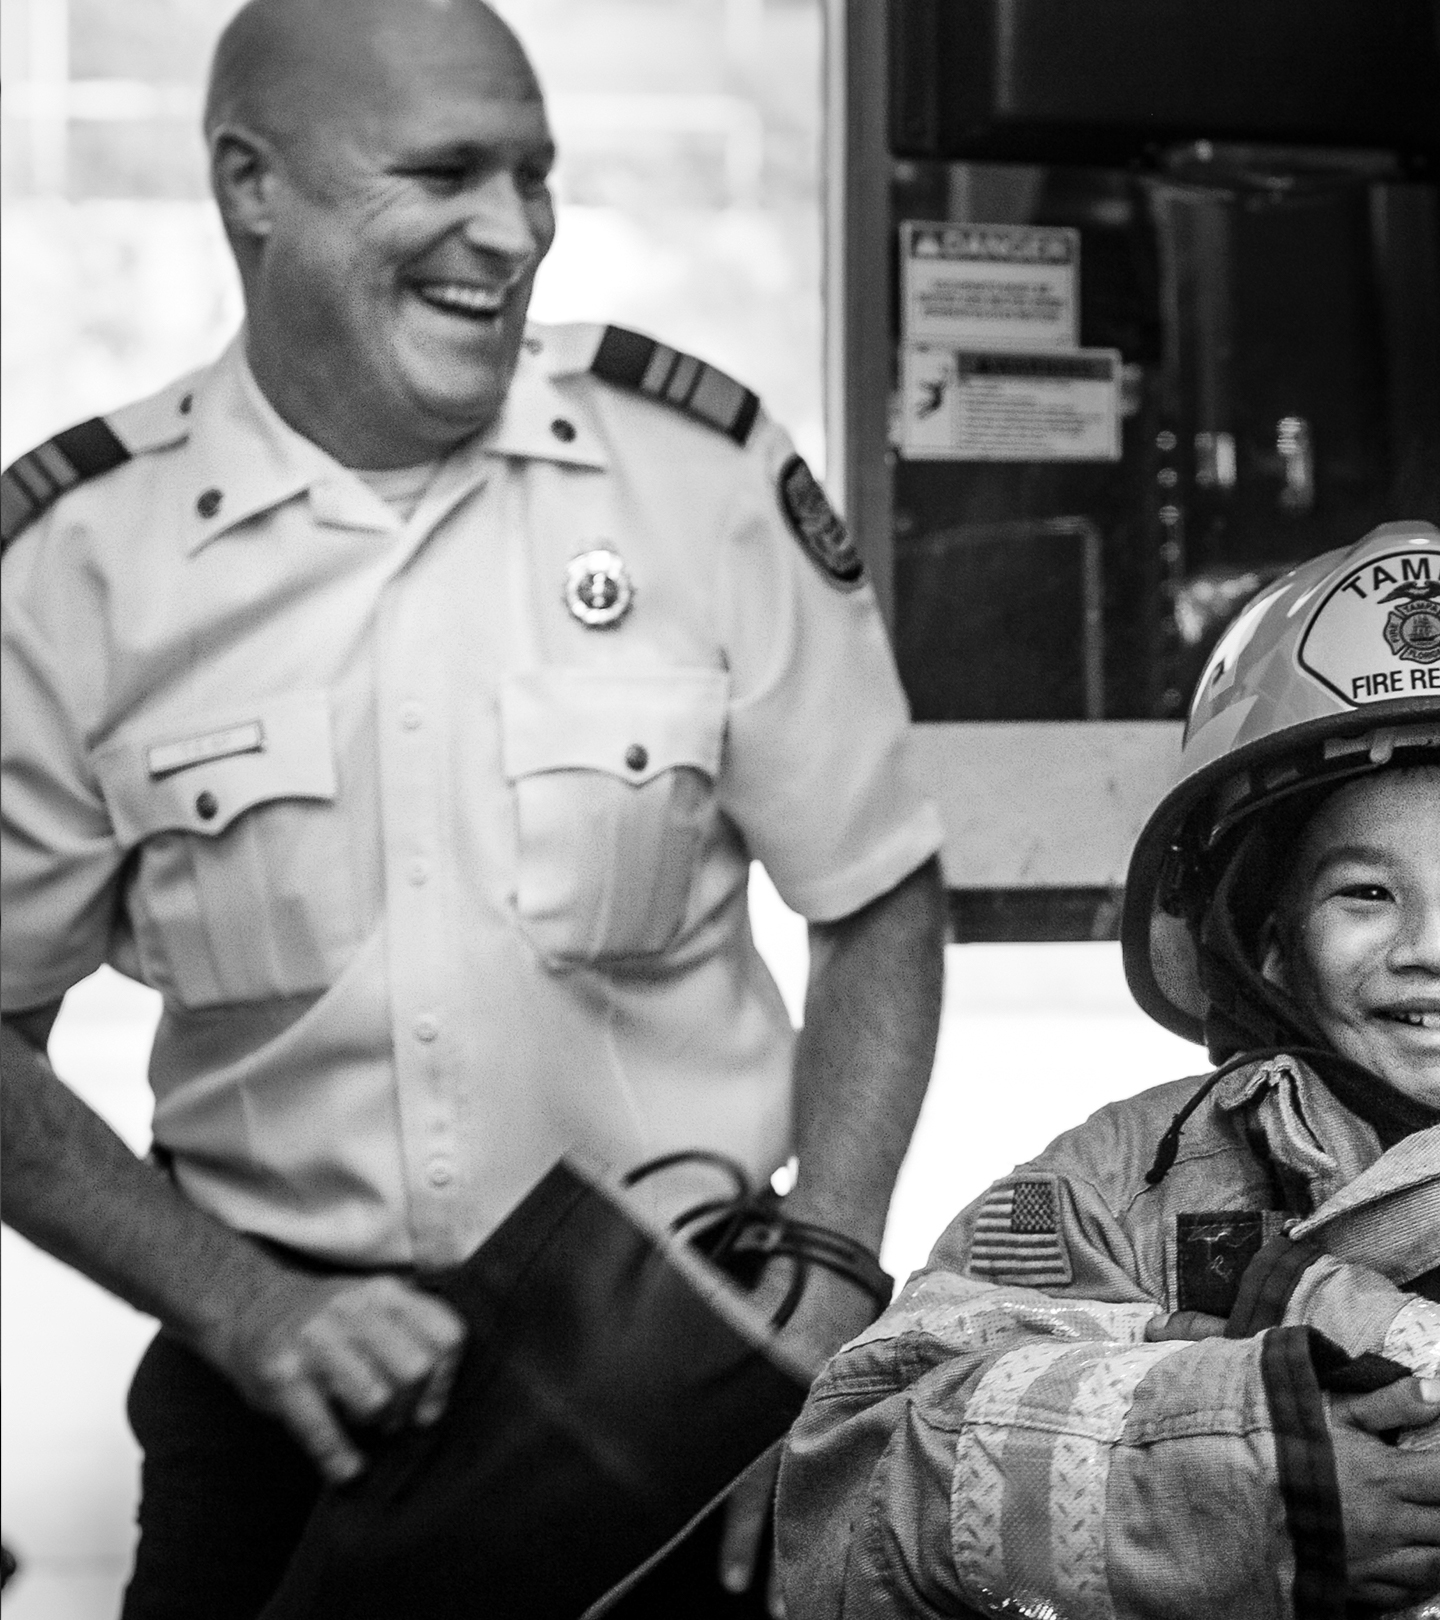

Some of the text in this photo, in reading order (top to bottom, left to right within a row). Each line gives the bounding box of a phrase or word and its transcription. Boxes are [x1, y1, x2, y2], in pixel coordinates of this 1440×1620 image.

[1402, 602, 1438, 612] TAMPA
[1389, 622, 1400, 643] FIRE
[1352, 670, 1404, 699] FIRE
